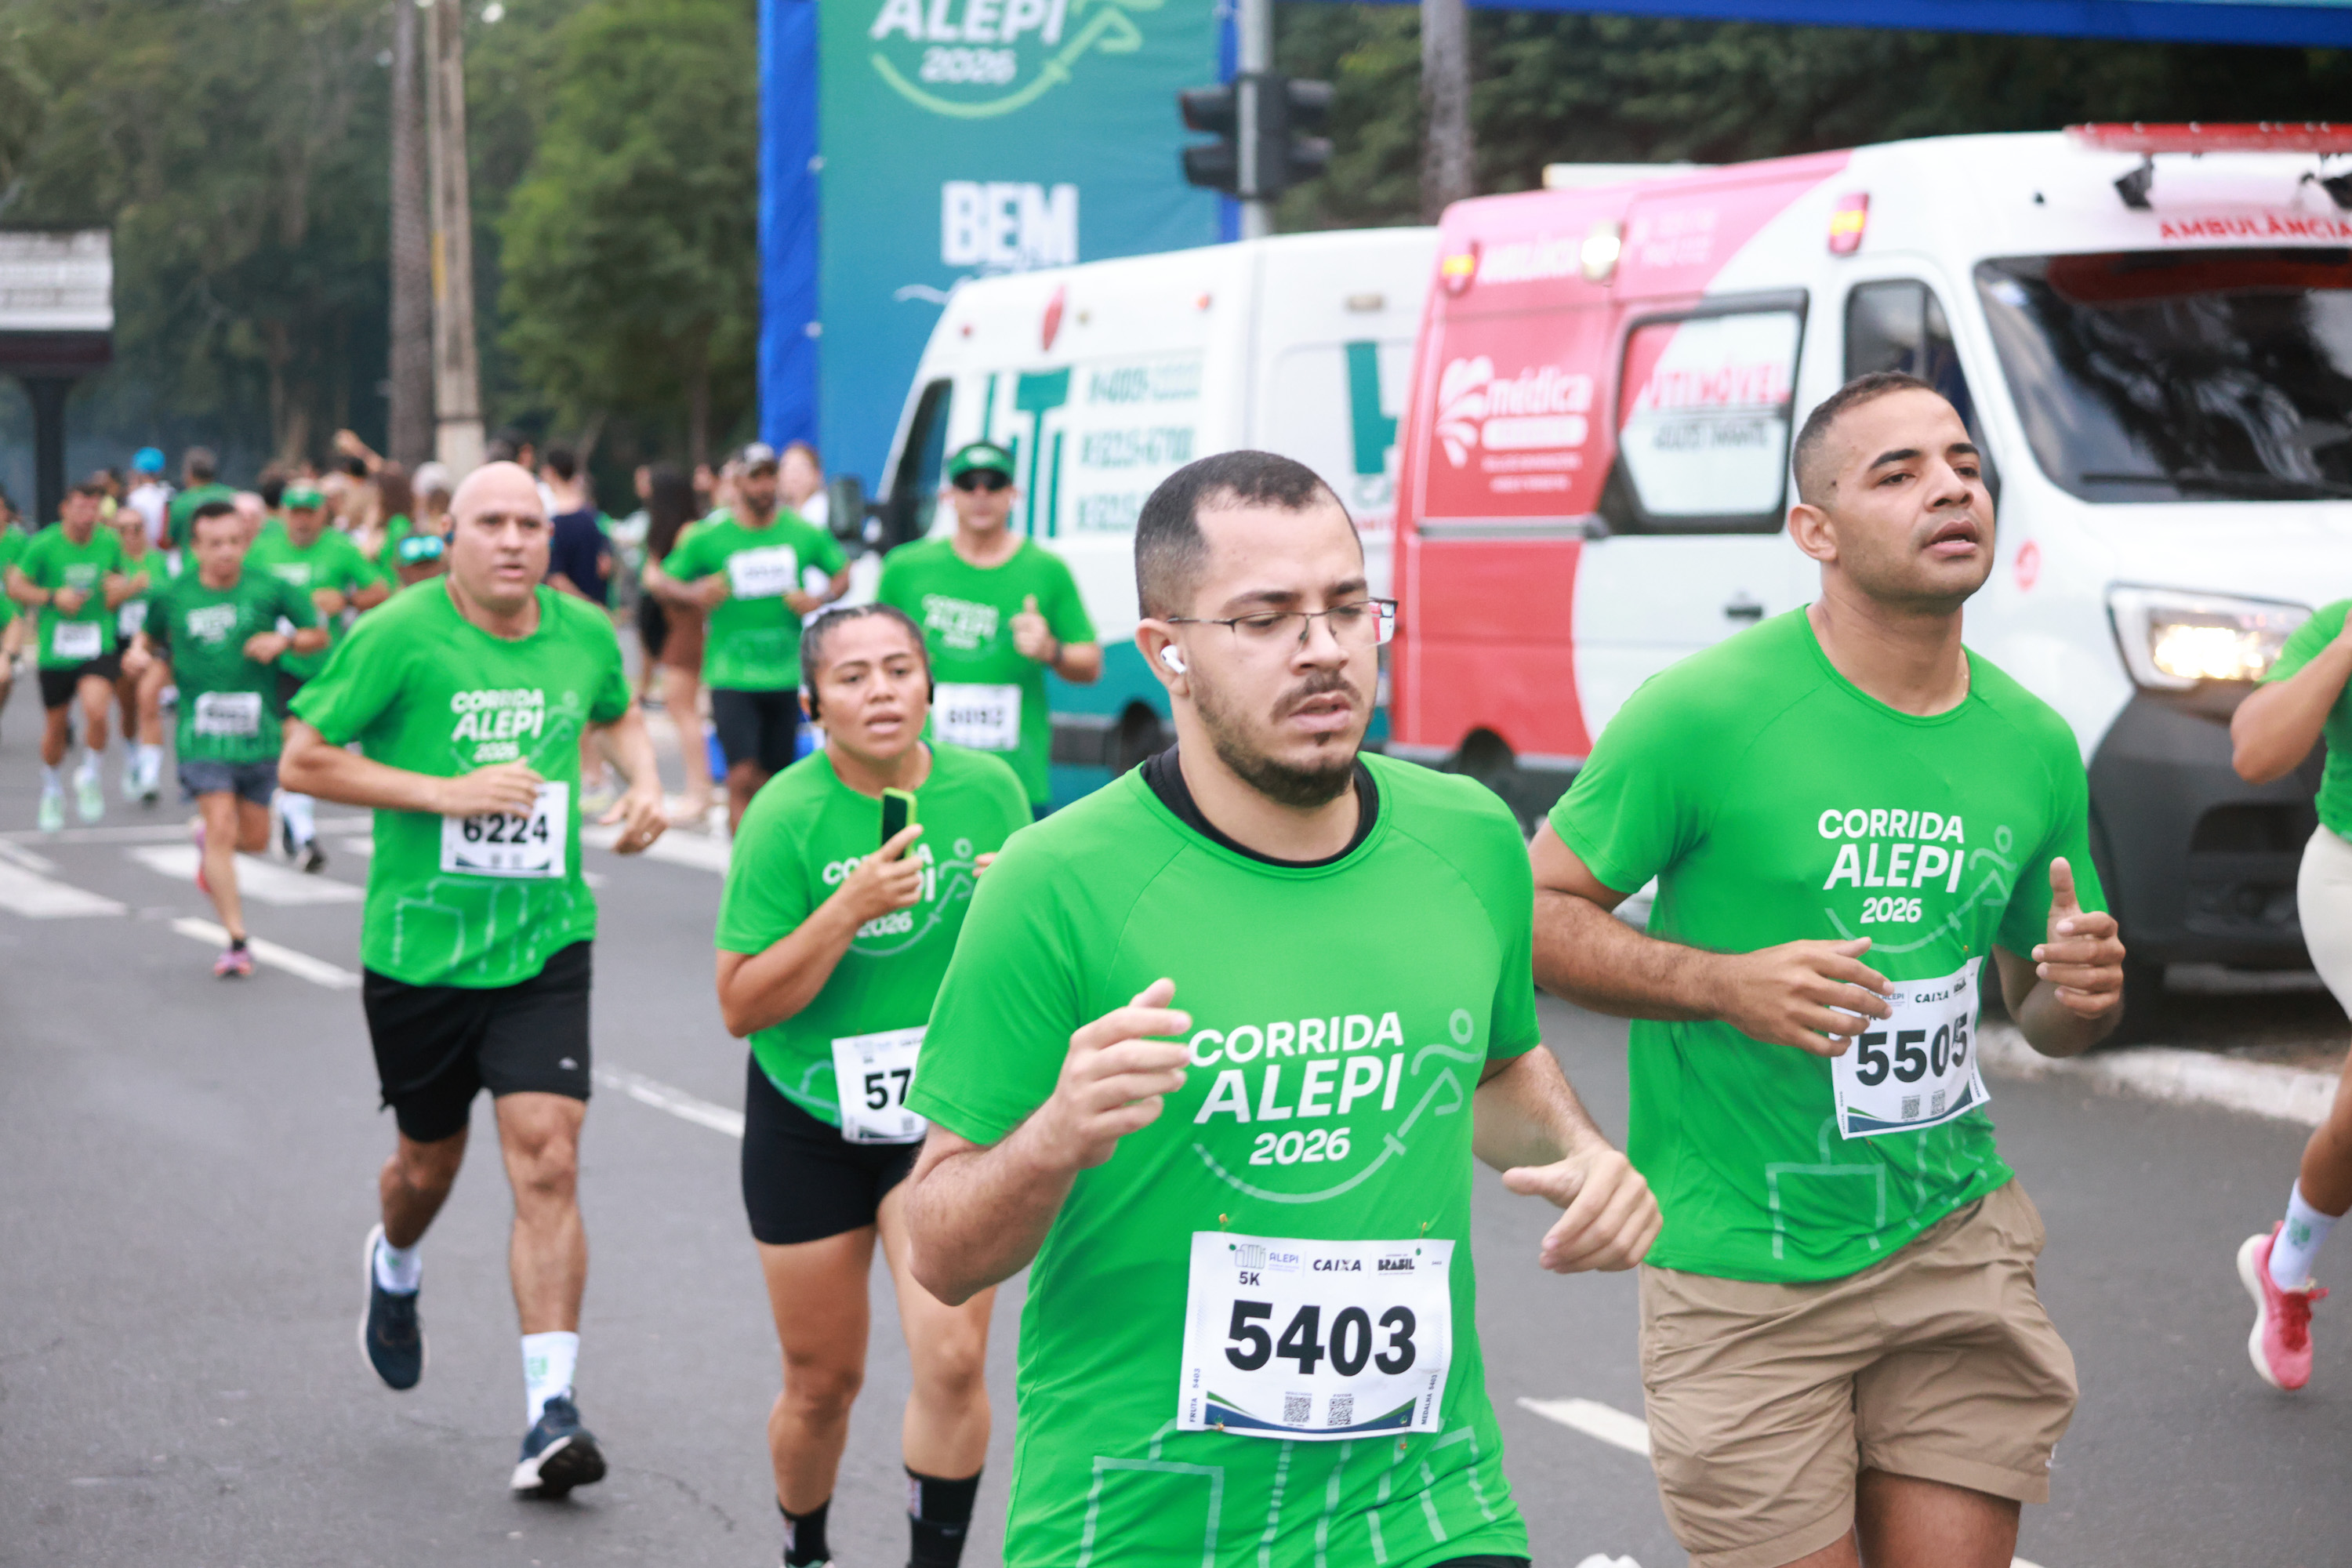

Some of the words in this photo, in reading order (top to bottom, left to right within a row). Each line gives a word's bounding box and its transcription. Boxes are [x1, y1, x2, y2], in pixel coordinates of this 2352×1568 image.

[867, 0, 1067, 45] ALEPI
[942, 182, 1079, 265] BEM
[452, 707, 544, 742] ALEPI
[463, 813, 548, 844] 6224
[1817, 808, 1965, 844] CORRIDA
[1822, 843, 1965, 893] ALEPI
[1860, 897, 1922, 924] 2026
[1915, 990, 1949, 1004] CAIXA
[1188, 1011, 1404, 1067] CORRIDA
[1856, 1011, 1968, 1086] 5505
[1193, 1053, 1404, 1123] ALEPI
[1249, 1127, 1351, 1165] 2026
[1239, 1271, 1261, 1287] 5K
[1269, 1252, 1299, 1263] ALEPI
[1313, 1258, 1361, 1272] CAIXA
[1377, 1258, 1415, 1271] BRASIL
[1225, 1299, 1416, 1377] 5403
[1192, 1367, 1201, 1388] 5403
[1428, 1374, 1438, 1391] 5403
[1189, 1397, 1199, 1423] FRUTA
[1421, 1392, 1433, 1425] MEDALHA
